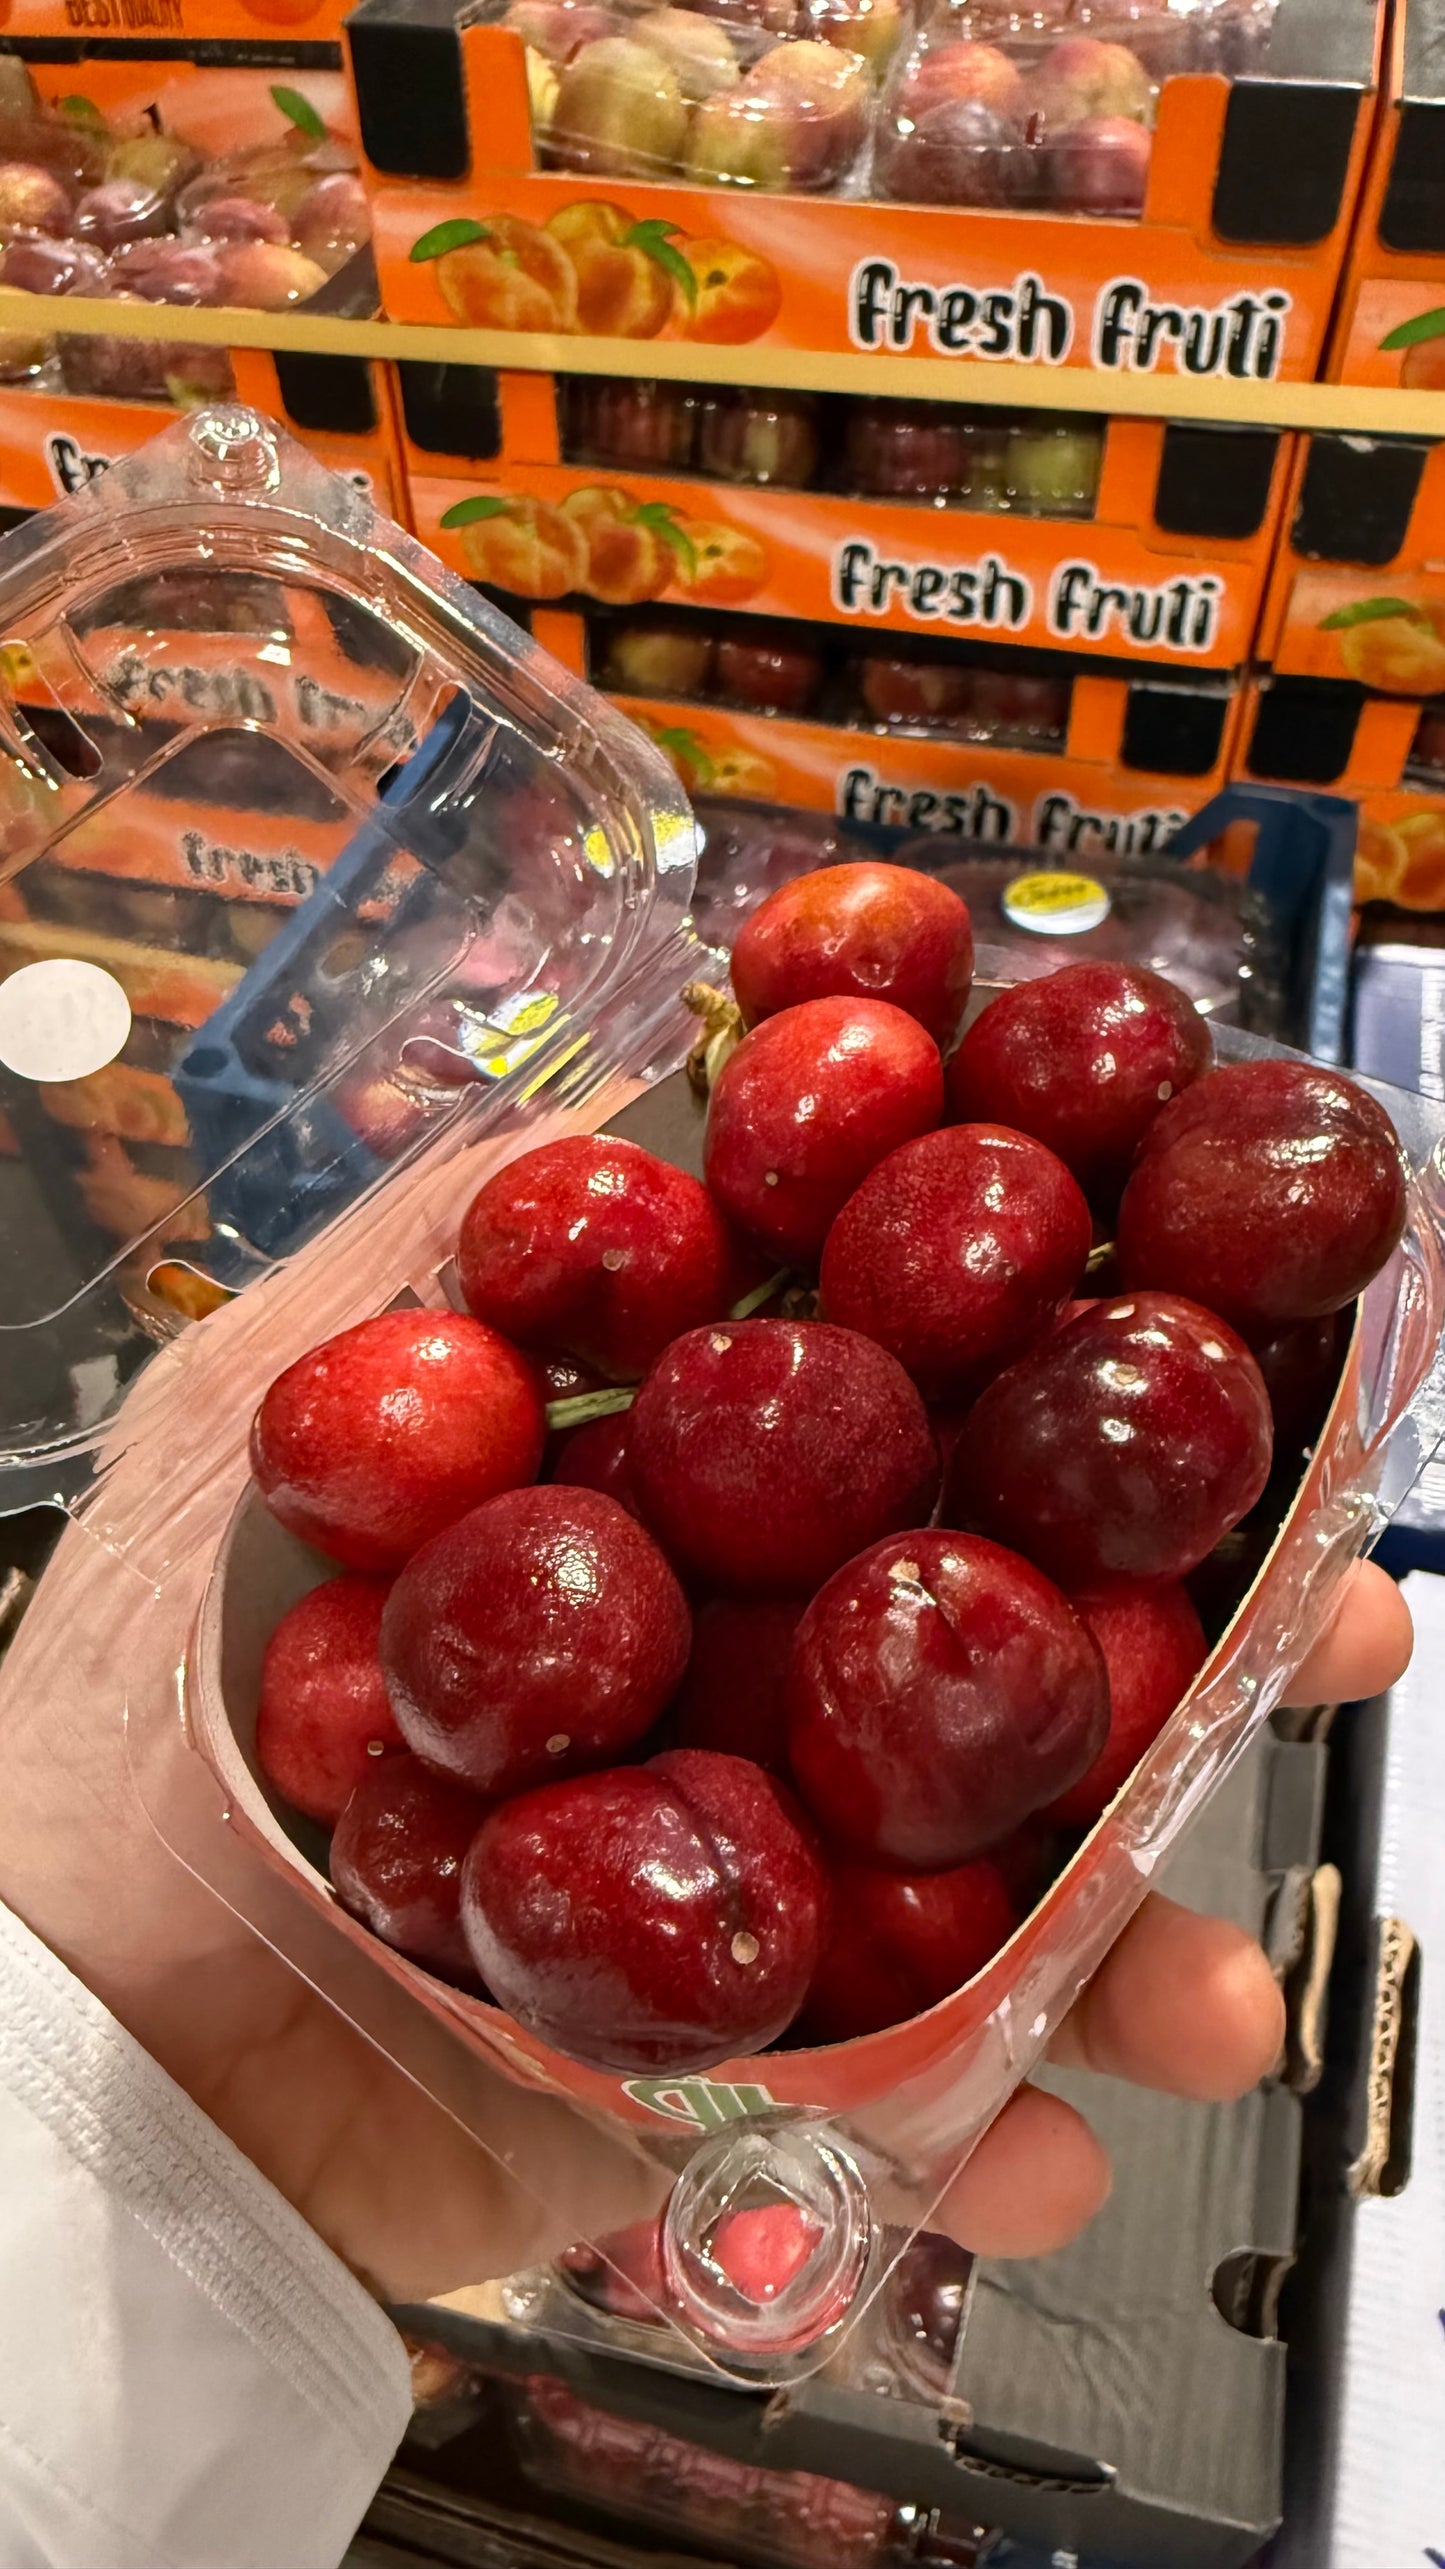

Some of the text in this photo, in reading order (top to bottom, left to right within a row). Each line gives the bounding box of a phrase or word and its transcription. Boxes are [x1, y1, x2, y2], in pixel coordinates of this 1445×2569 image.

[855, 260, 1289, 379] fresh fruti
[836, 540, 1219, 650] fresh fruti
[840, 770, 1013, 843] fresh
